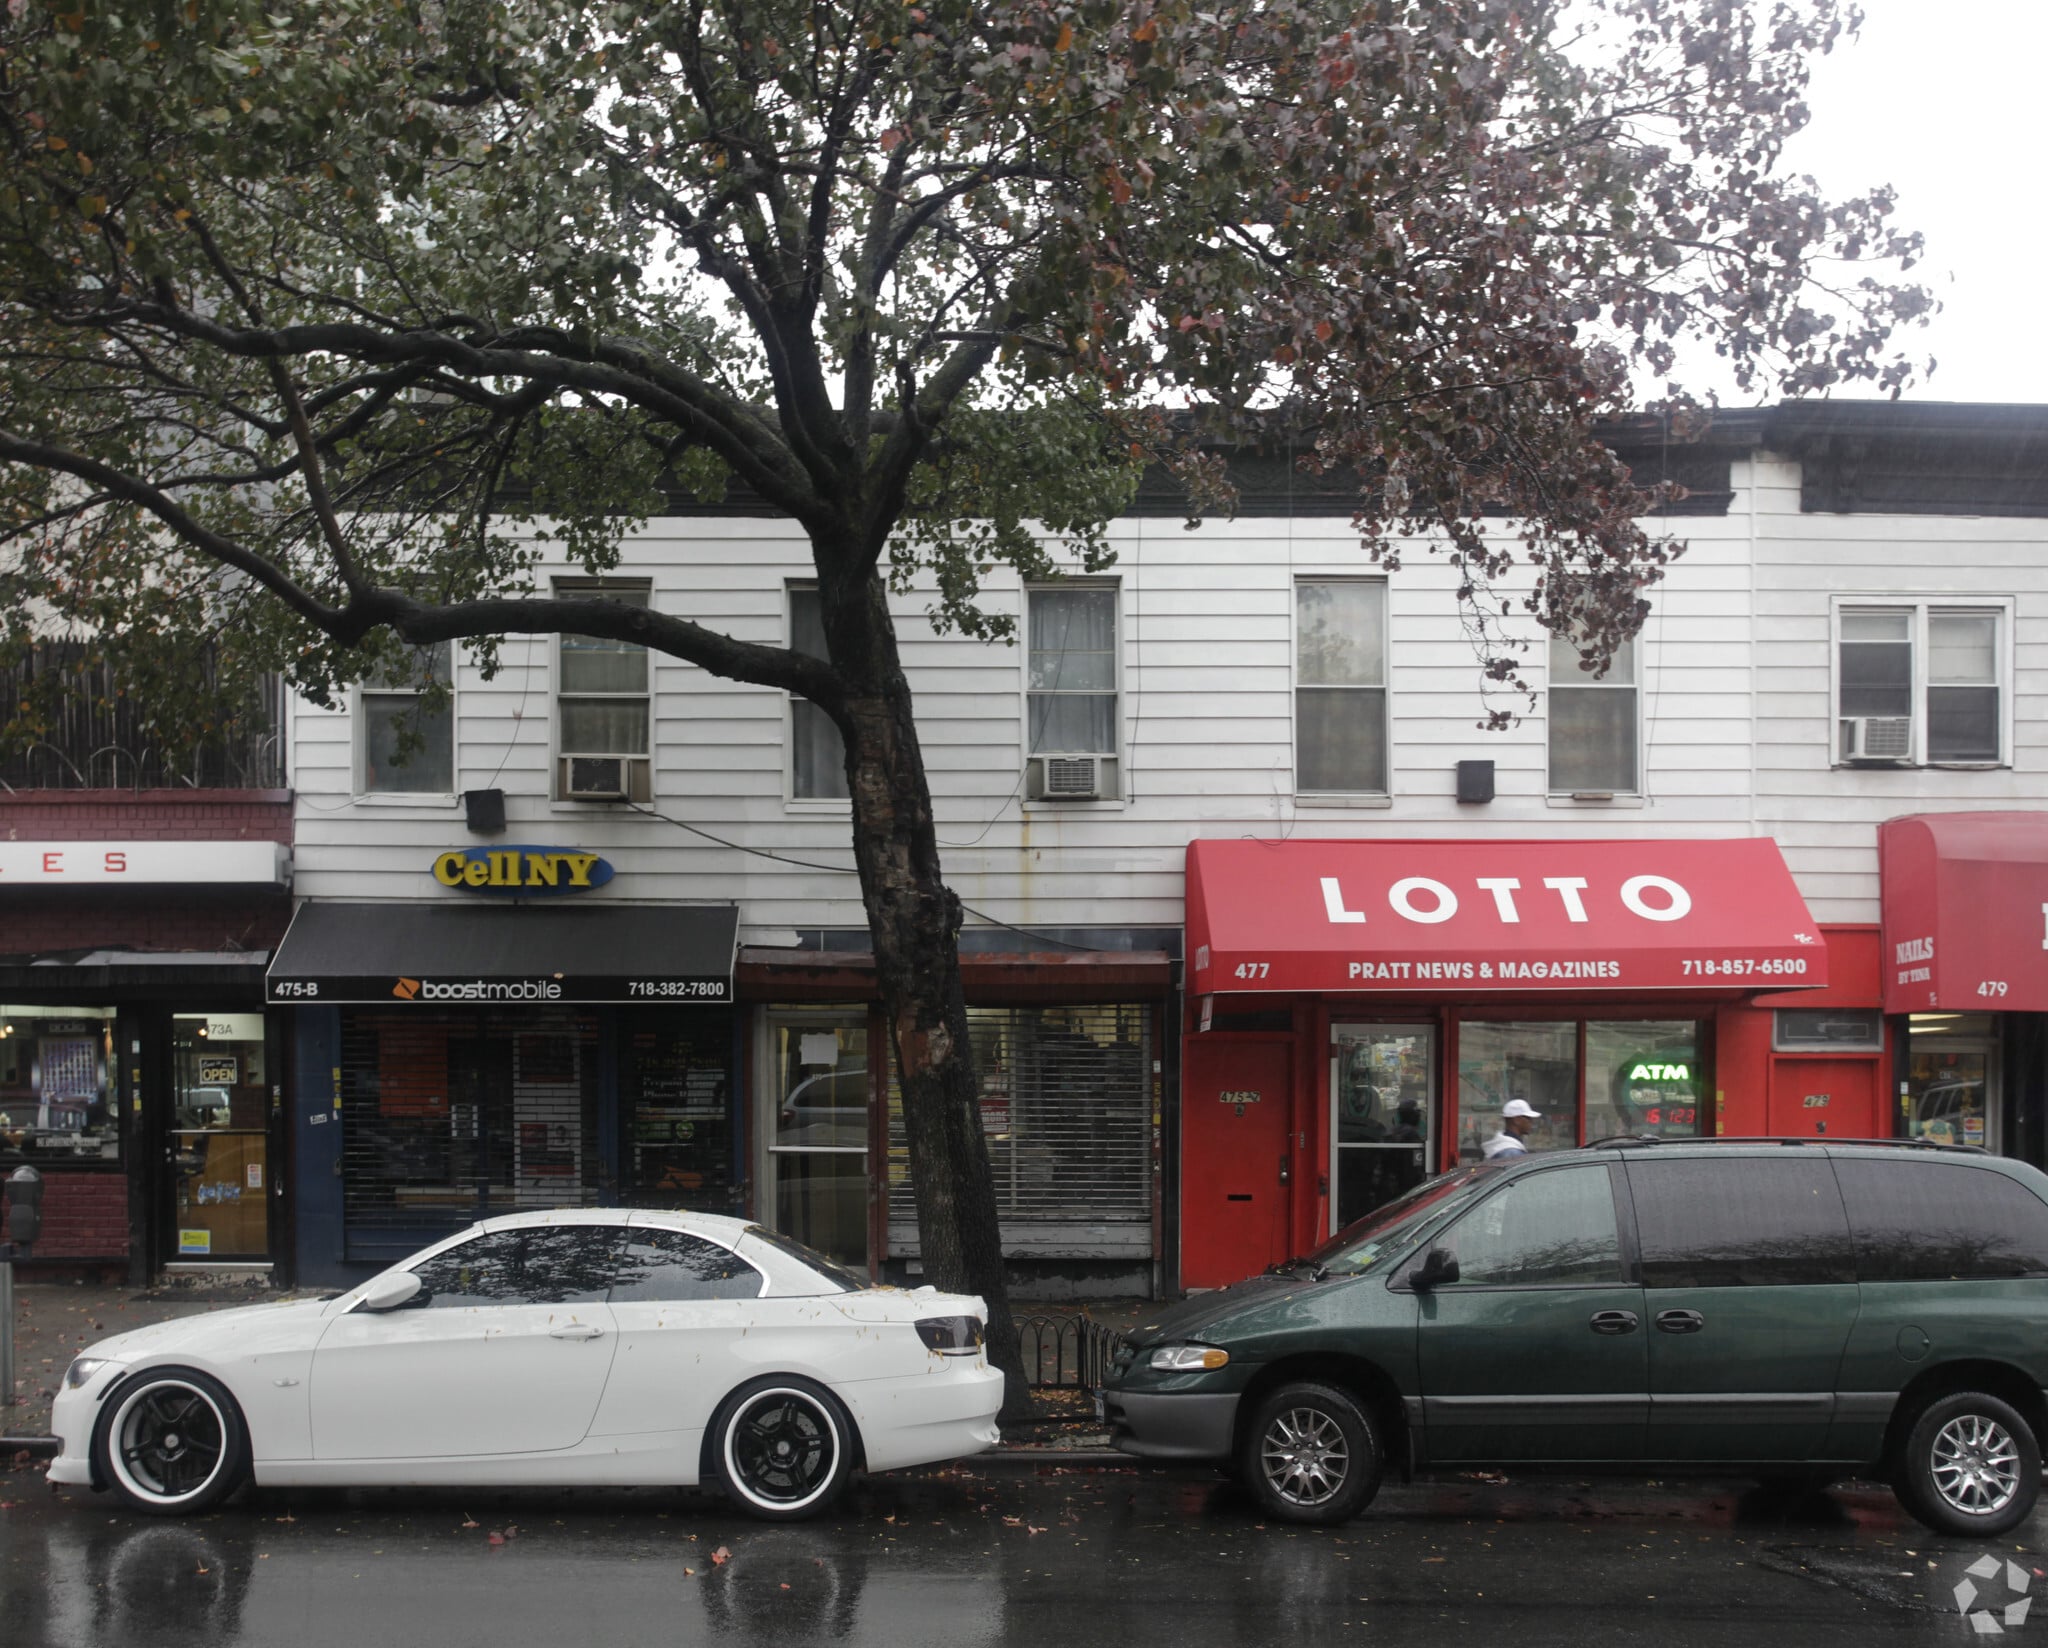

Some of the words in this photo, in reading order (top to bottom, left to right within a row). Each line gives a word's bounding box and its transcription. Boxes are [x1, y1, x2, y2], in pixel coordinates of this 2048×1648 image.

[0, 852, 127, 873] ES
[1320, 875, 1692, 924] LOTTO
[1896, 937, 1934, 965] NAILS
[1234, 963, 1270, 979] 477
[1348, 963, 1411, 979] PRATT
[1416, 962, 1474, 979] NEWS
[1479, 962, 1493, 978] &
[1498, 960, 1621, 978] MAGAZINES
[1682, 958, 1807, 975] 718-857-6500
[275, 983, 318, 996] 475-B
[628, 982, 725, 997] 718-382-7800
[1977, 981, 2008, 997] 479
[202, 1068, 235, 1081] OPEN
[1630, 1064, 1689, 1080] ATM
[1804, 1095, 1829, 1107] 479
